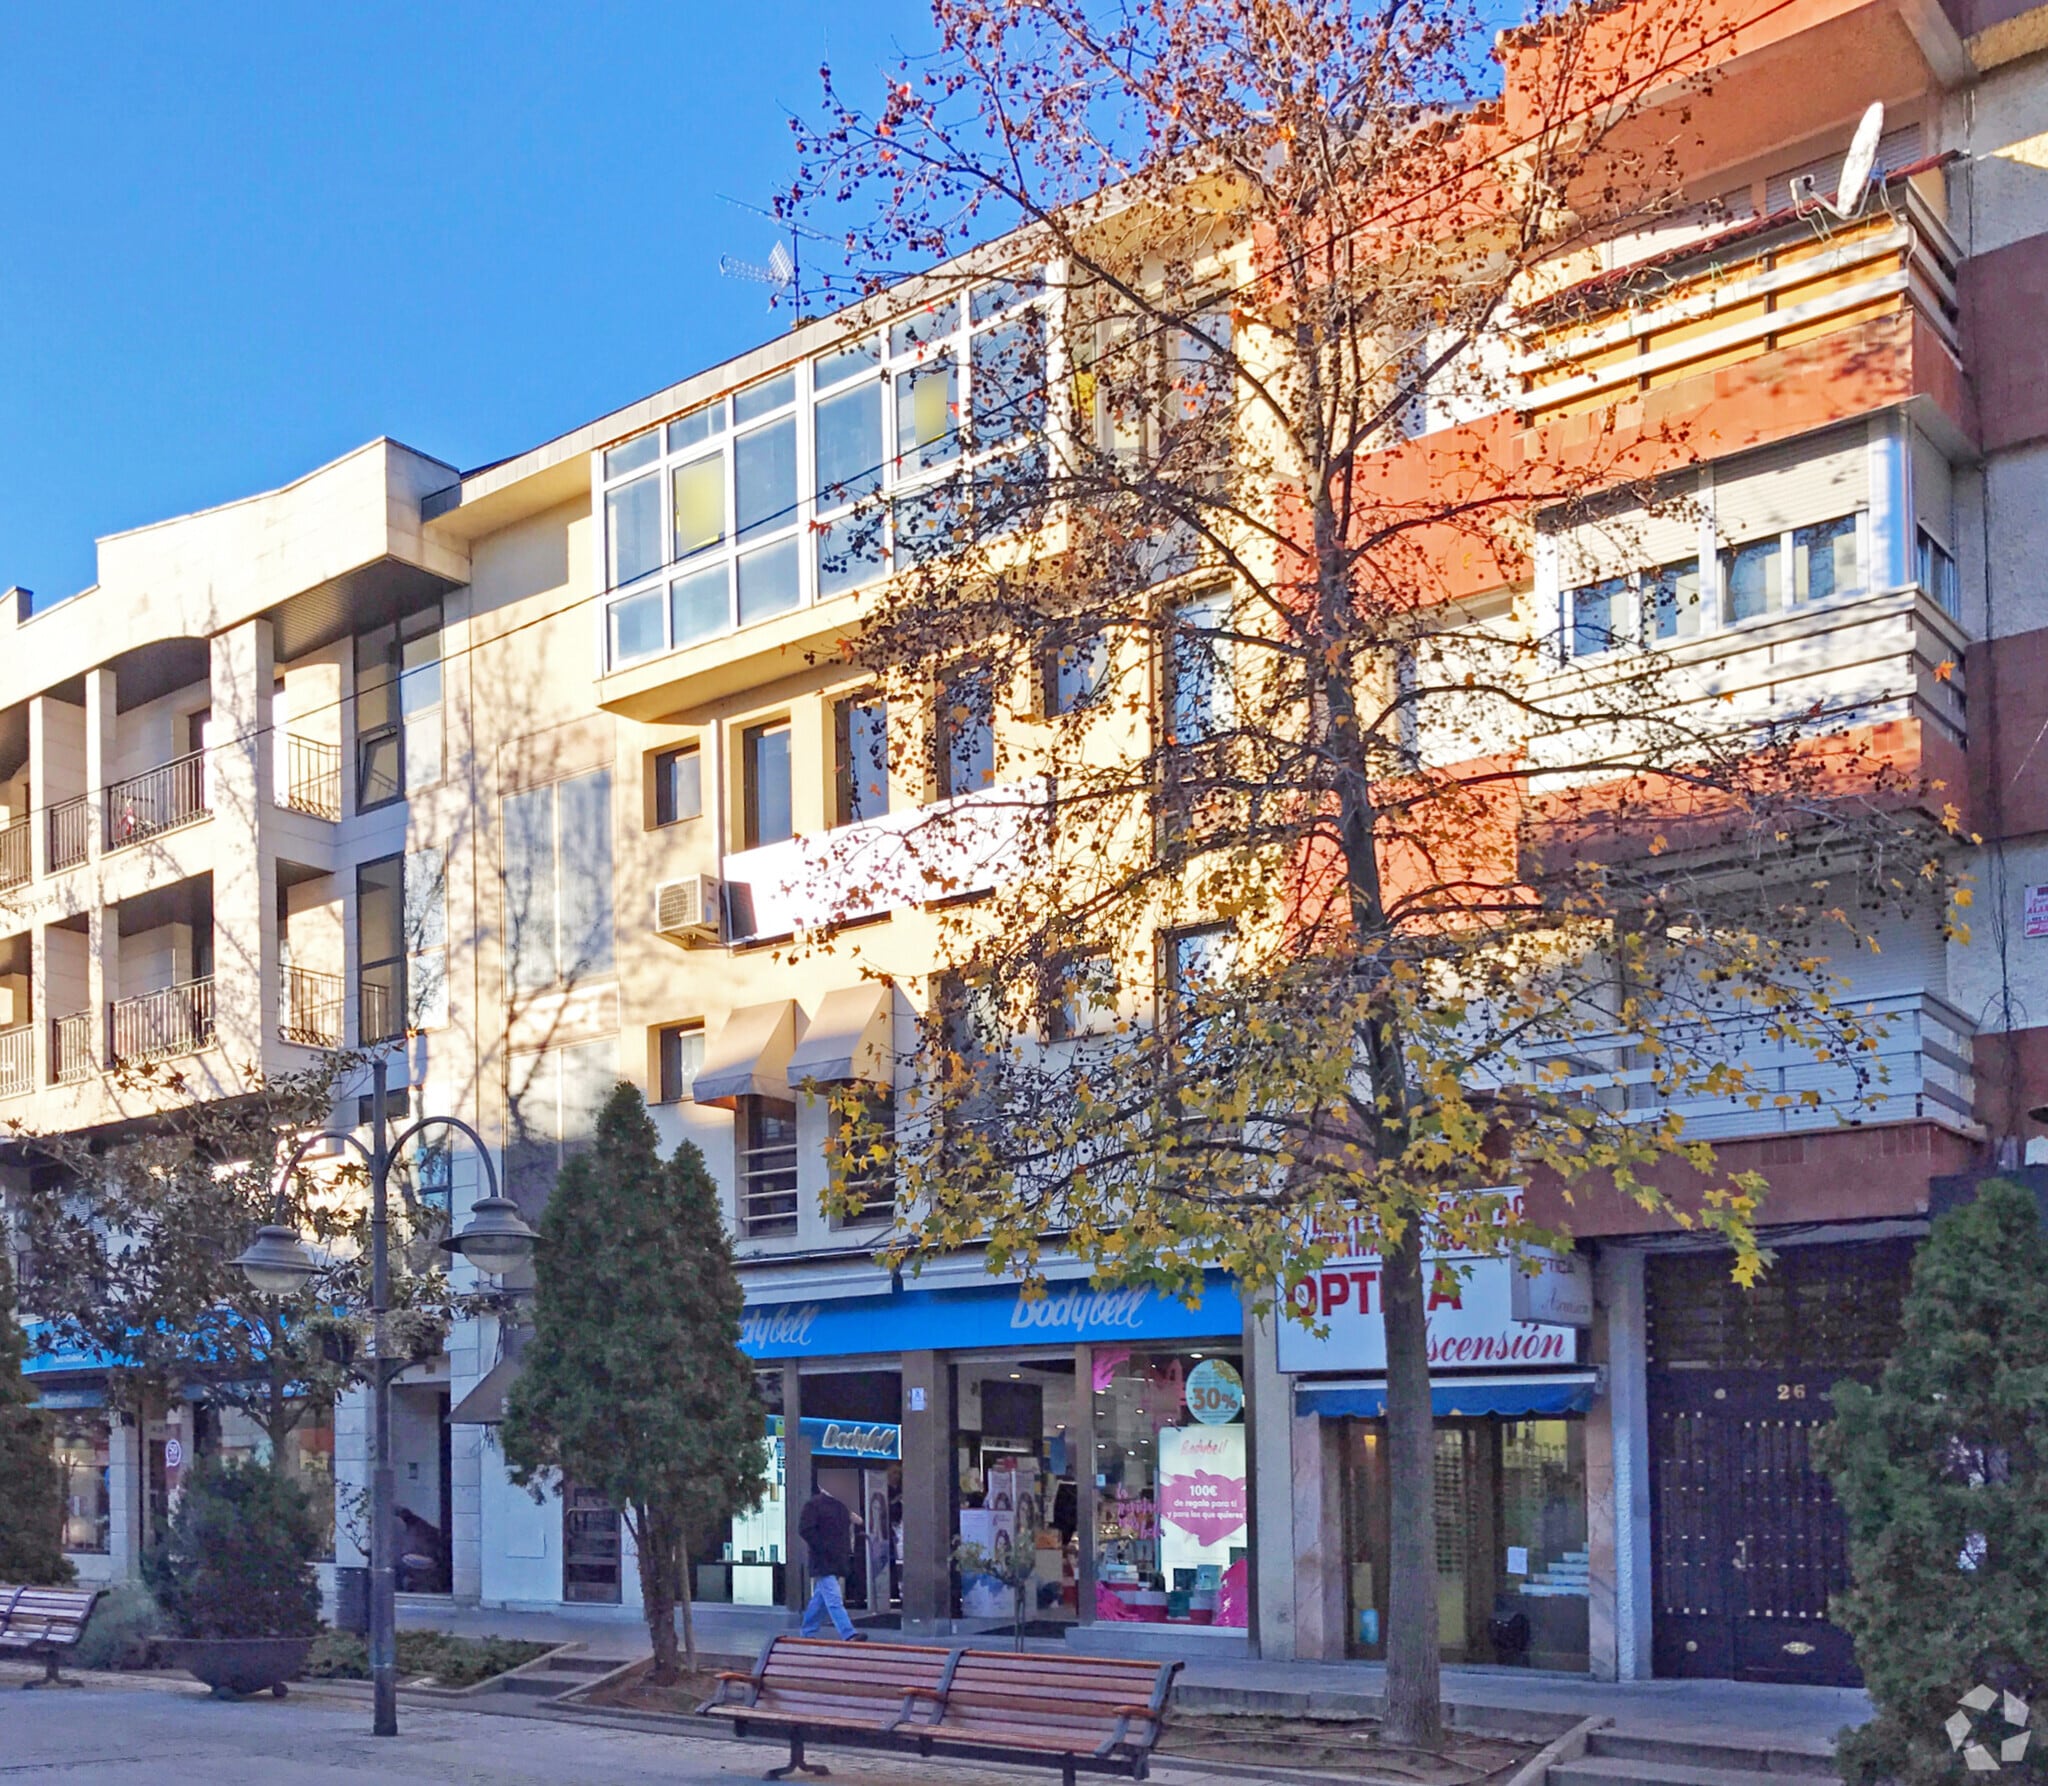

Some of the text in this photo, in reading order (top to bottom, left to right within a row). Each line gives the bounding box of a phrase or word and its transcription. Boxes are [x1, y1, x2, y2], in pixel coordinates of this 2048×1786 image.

[1286, 1271, 1463, 1317] OPTA
[740, 1304, 819, 1350] dybell
[1424, 1320, 1564, 1362] scensión
[1777, 1384, 1806, 1400] 26
[1189, 1485, 1218, 1497] 100€
[1173, 1499, 1183, 1507] de
[1185, 1499, 1210, 1508] regalo
[1211, 1500, 1230, 1508] para
[1173, 1511, 1190, 1519] para
[1202, 1511, 1216, 1519] que
